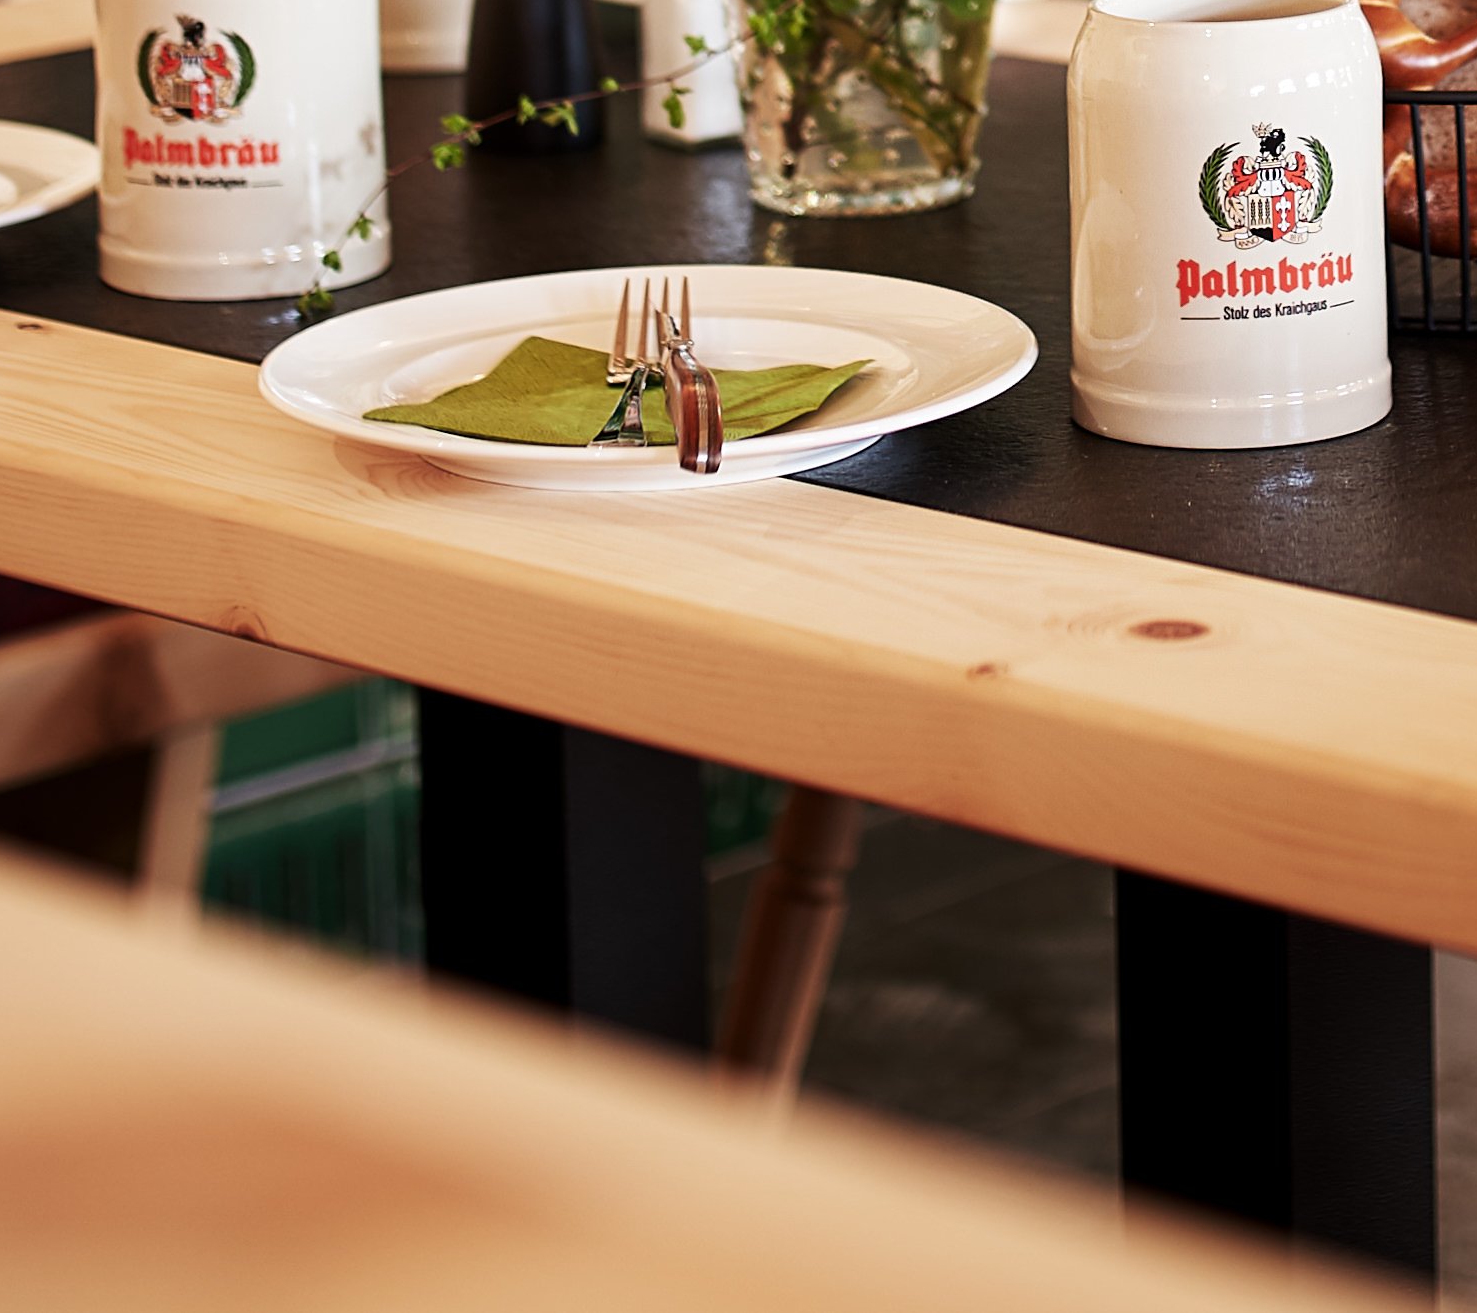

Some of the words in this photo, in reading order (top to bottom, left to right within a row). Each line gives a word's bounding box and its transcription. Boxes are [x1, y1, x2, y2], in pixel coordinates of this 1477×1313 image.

[124, 127, 279, 169] Palmbräu
[1176, 252, 1354, 307] Palmbräu
[1223, 306, 1249, 320] Stolz
[1253, 305, 1272, 319] des
[1275, 299, 1328, 317] Kraichgaus
